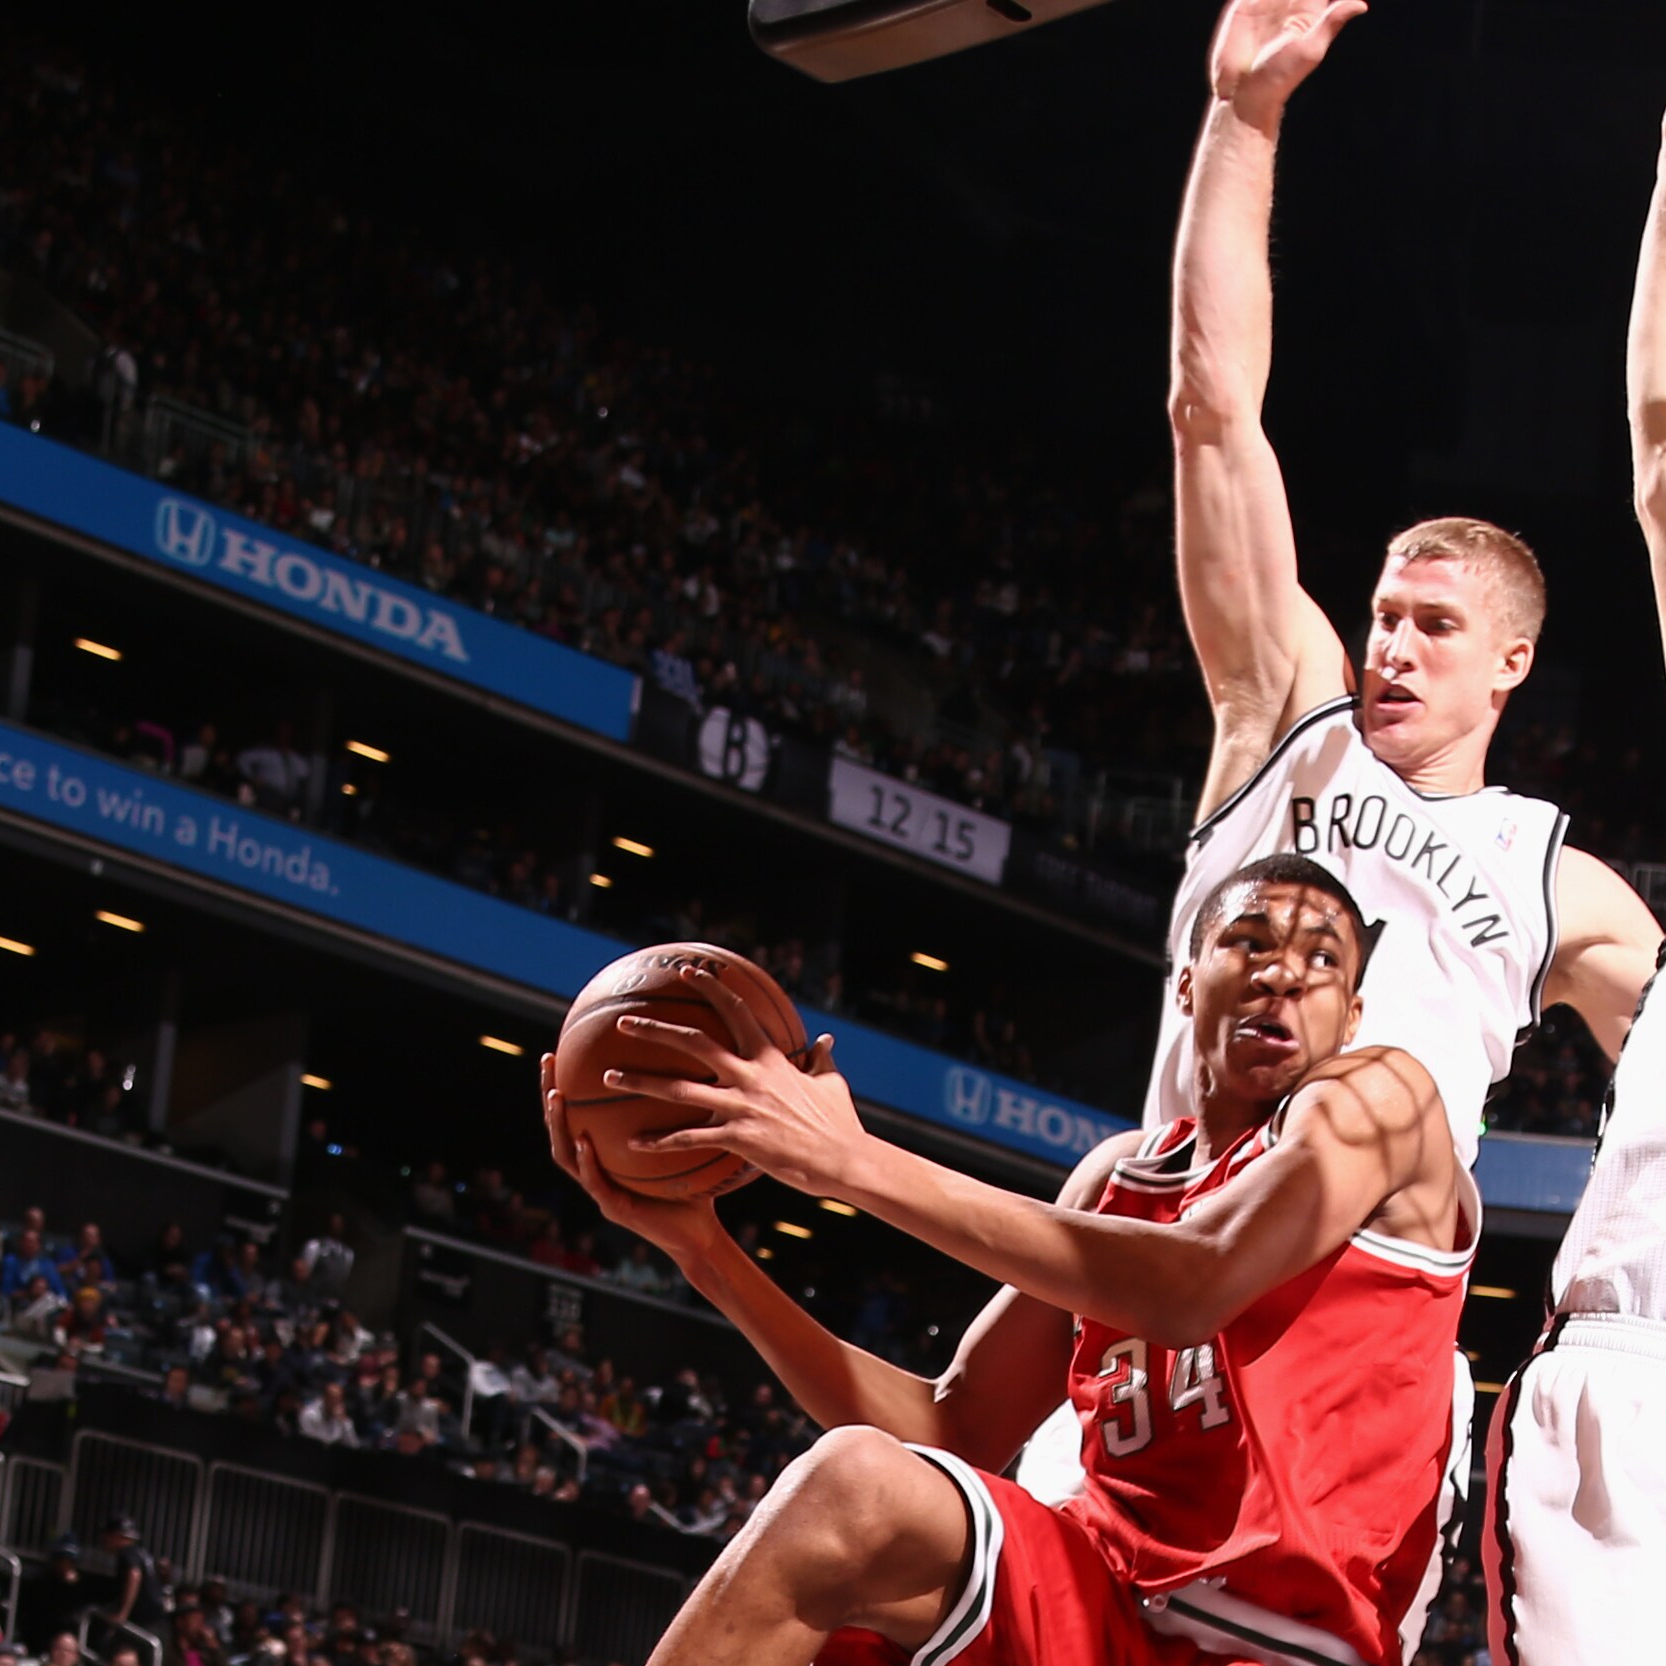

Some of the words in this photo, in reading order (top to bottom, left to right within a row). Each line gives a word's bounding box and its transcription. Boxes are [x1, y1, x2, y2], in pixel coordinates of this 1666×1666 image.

[219, 528, 470, 662] HONDA
[46, 763, 88, 808] to
[98, 790, 164, 837] win
[174, 815, 198, 848] a
[208, 814, 339, 898] Honda.
[868, 784, 910, 839] 12
[933, 811, 976, 860] 15
[1293, 795, 1510, 948] BROOKLYN
[993, 1088, 1126, 1157] HON
[1097, 1337, 1230, 1457] 34
